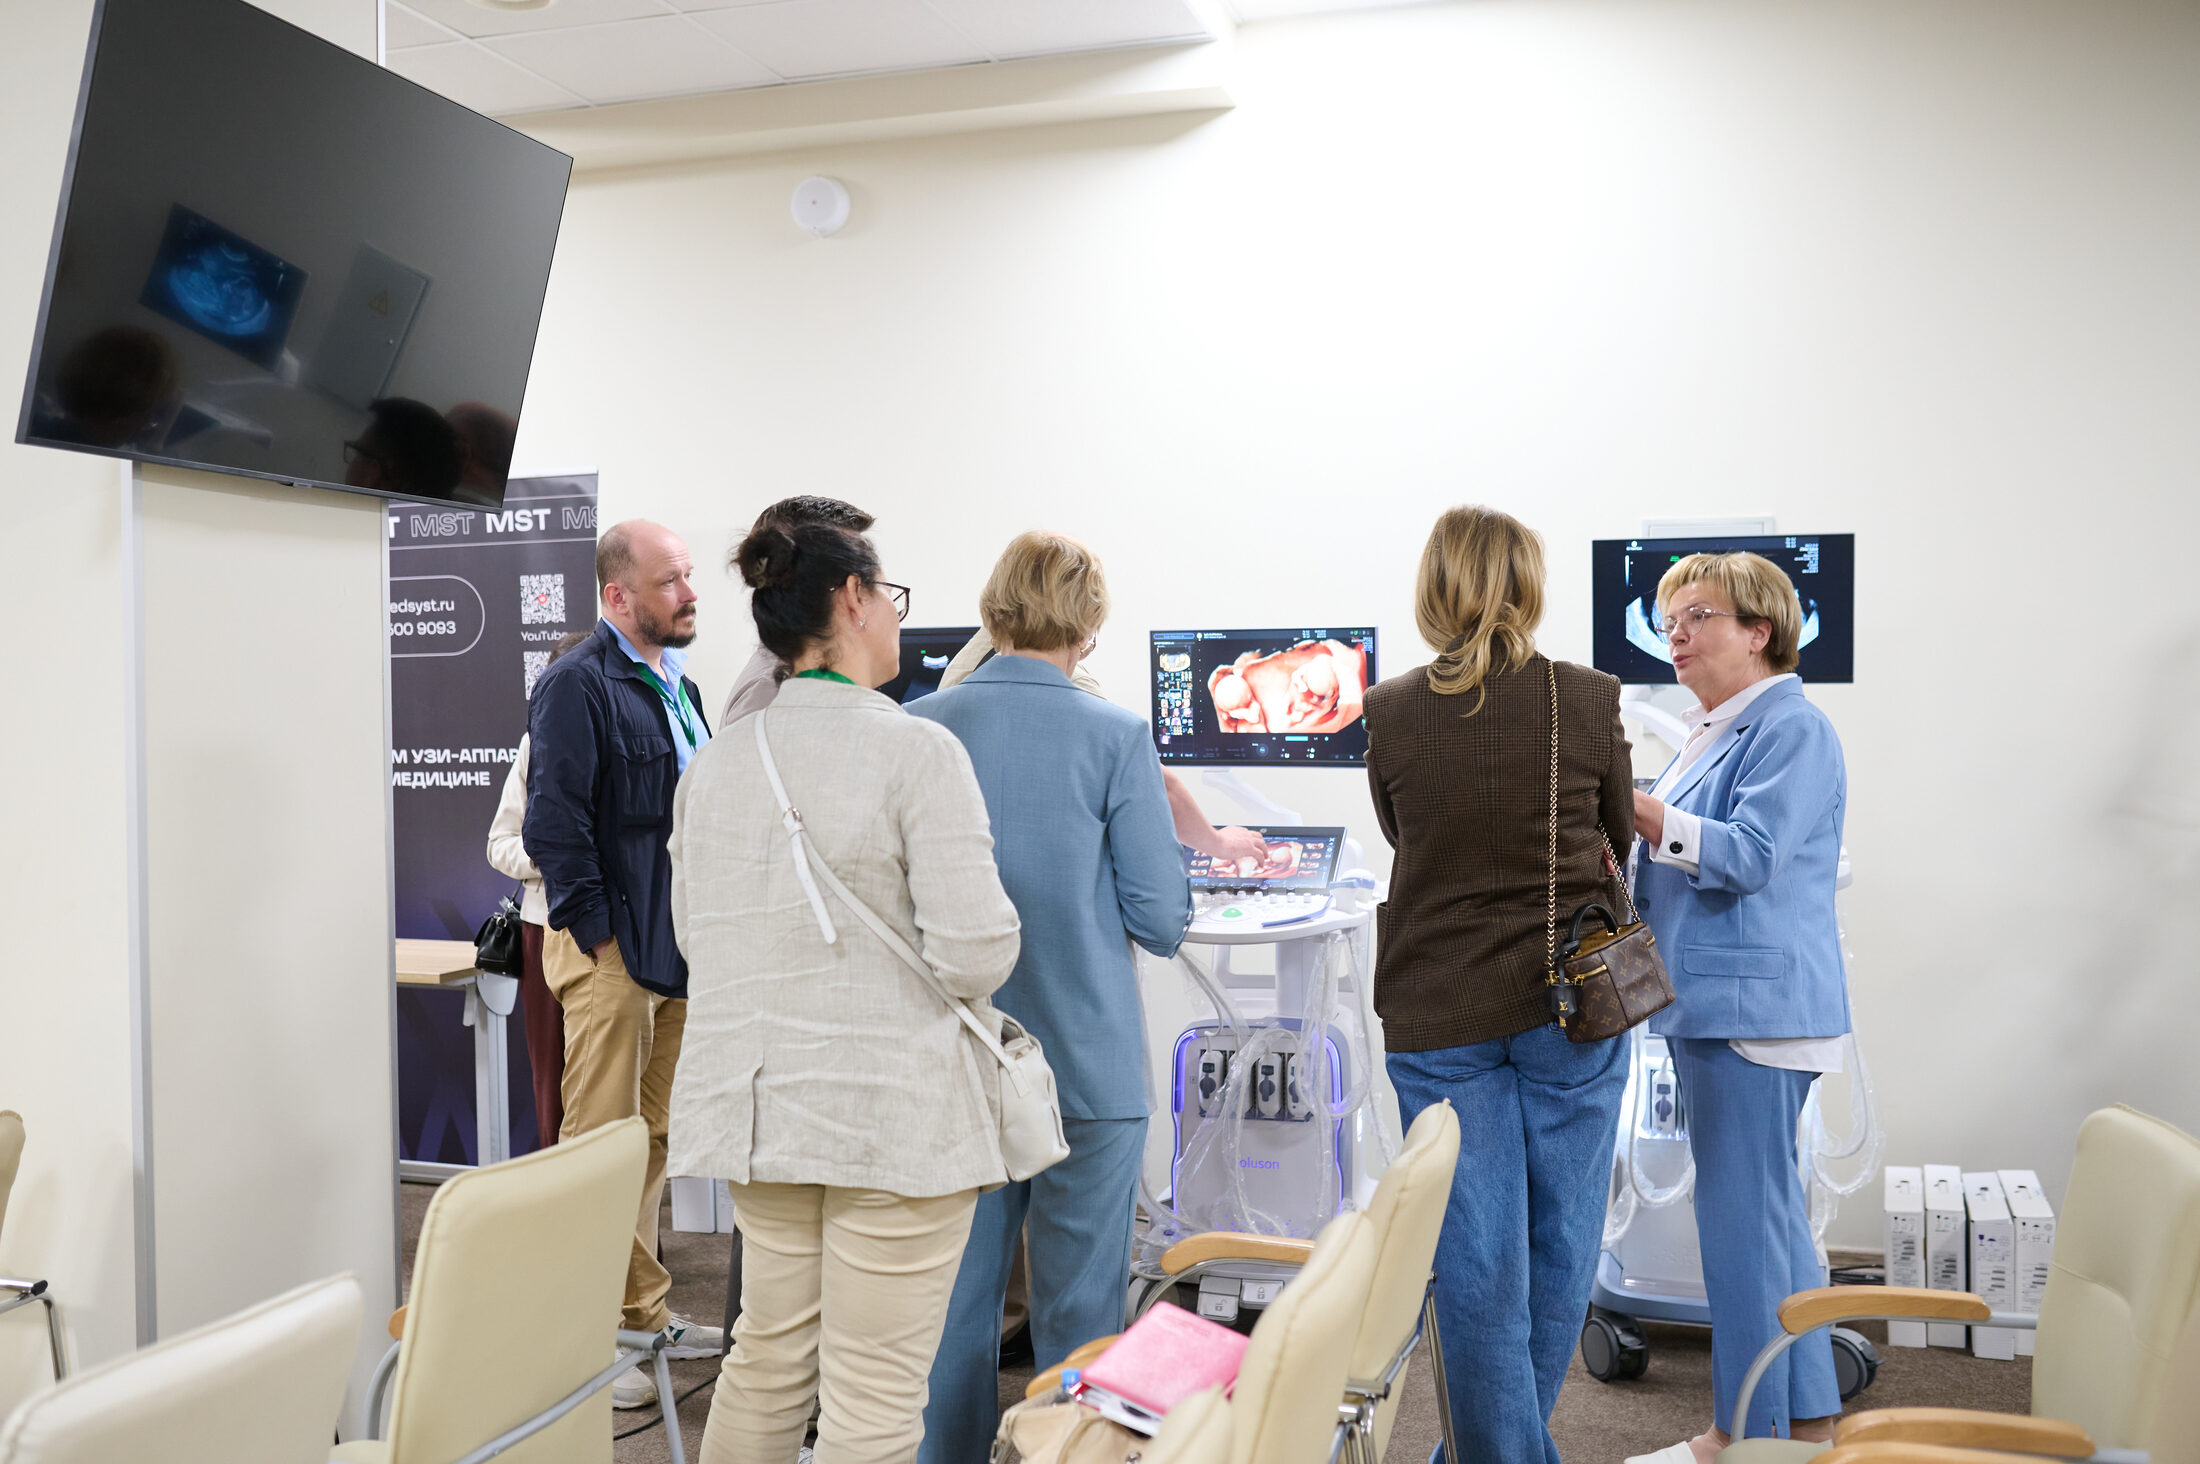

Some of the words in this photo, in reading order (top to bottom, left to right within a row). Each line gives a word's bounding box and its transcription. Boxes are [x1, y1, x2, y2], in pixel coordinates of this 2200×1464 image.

[410, 511, 475, 537] MST
[485, 508, 551, 533] MST
[417, 620, 456, 635] 9093
